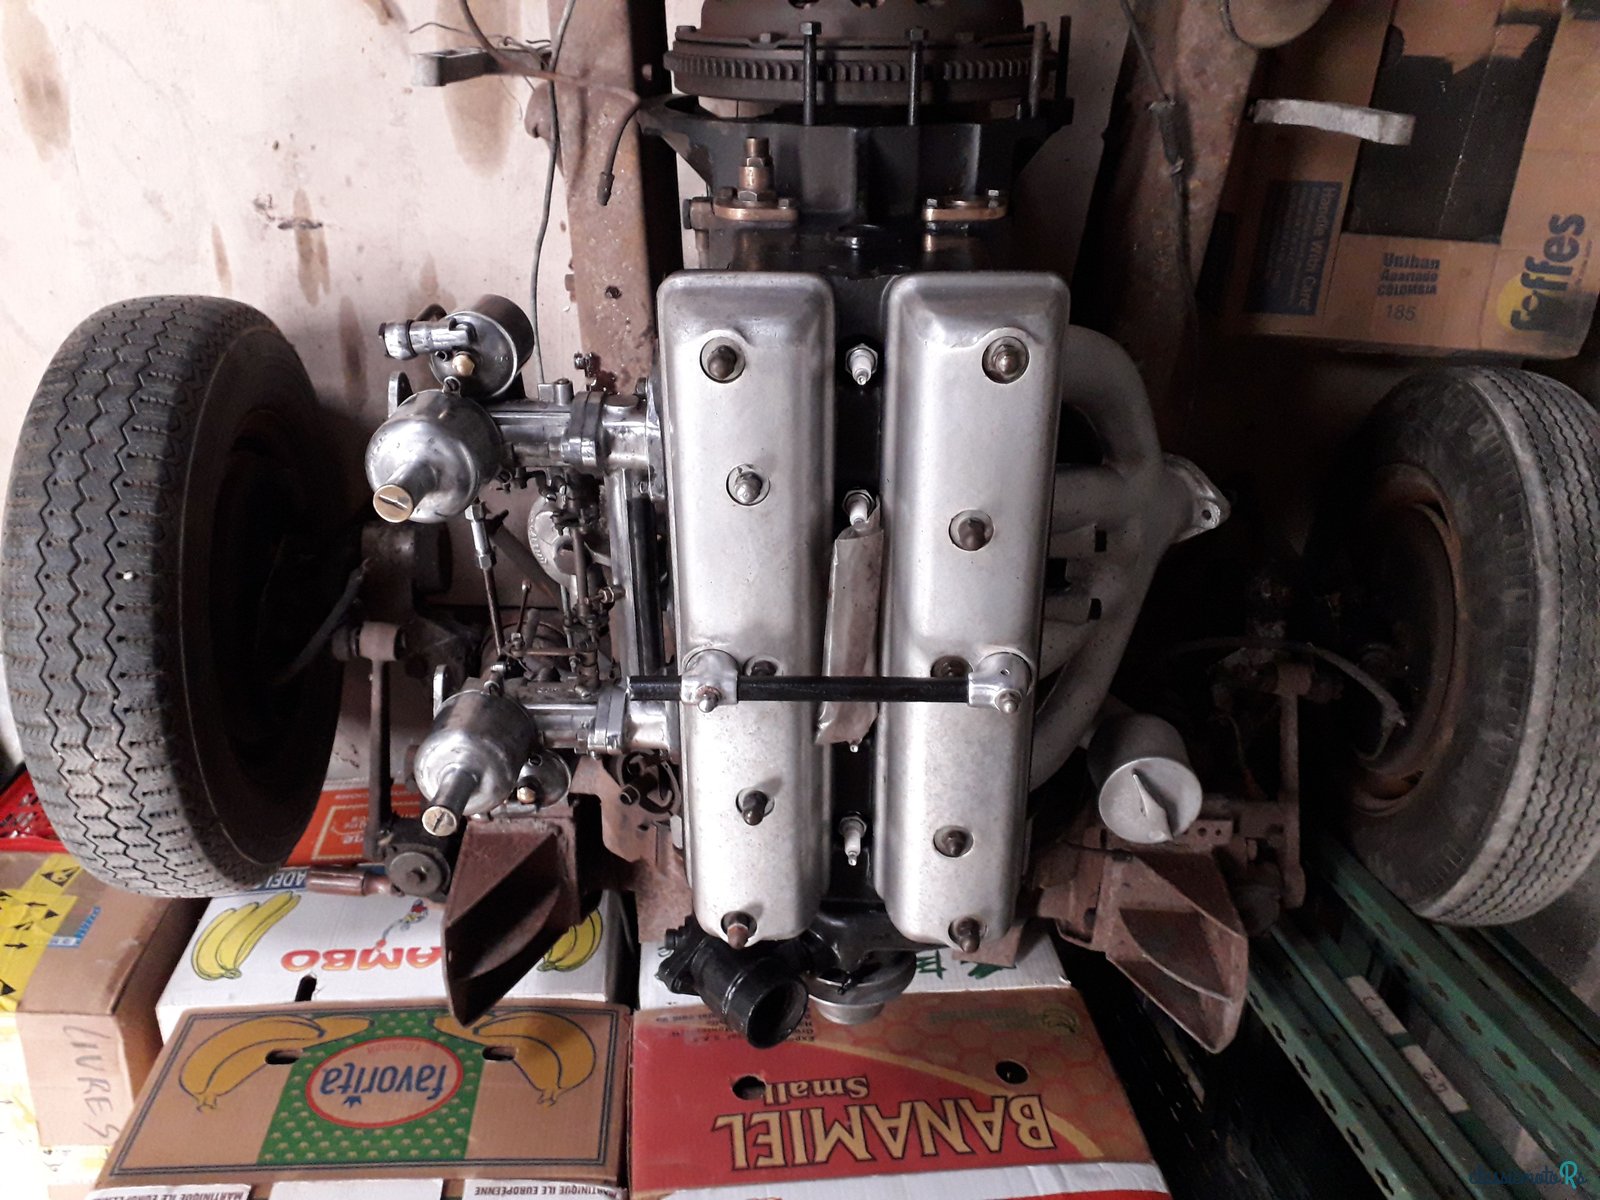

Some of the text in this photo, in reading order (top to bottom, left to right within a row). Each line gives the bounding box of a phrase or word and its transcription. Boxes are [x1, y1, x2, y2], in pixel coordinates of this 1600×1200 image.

[1312, 186, 1337, 237] Handle
[1386, 304, 1417, 321] 185
[280, 947, 442, 973] AMBO
[63, 1025, 121, 1139] LIVRES
[319, 1063, 447, 1101] favorita
[764, 1075, 869, 1106] Small
[712, 1095, 1056, 1171] BANAMIEL
